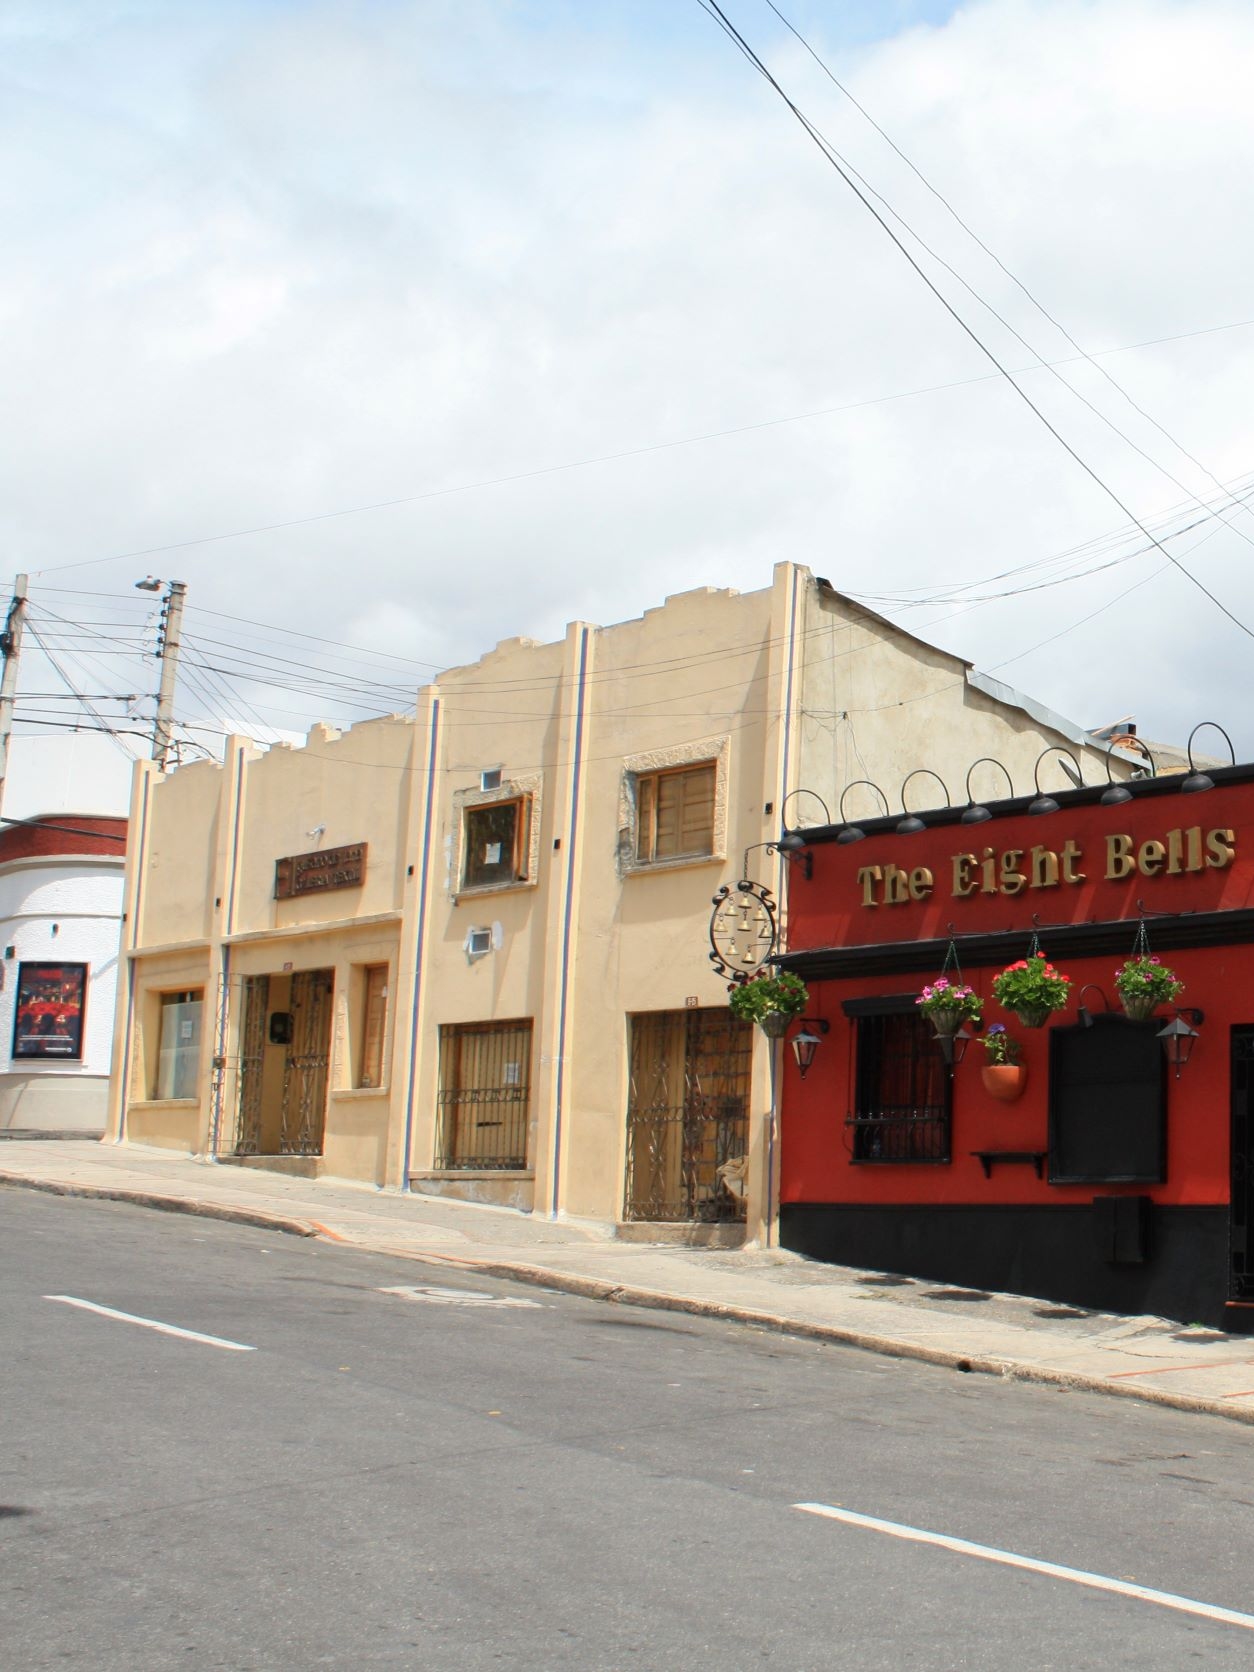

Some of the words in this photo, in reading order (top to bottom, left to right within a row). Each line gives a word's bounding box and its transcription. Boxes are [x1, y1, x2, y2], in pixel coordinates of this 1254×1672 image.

[856, 863, 935, 907] The
[950, 846, 1087, 898] Eight
[1103, 826, 1236, 880] Bells
